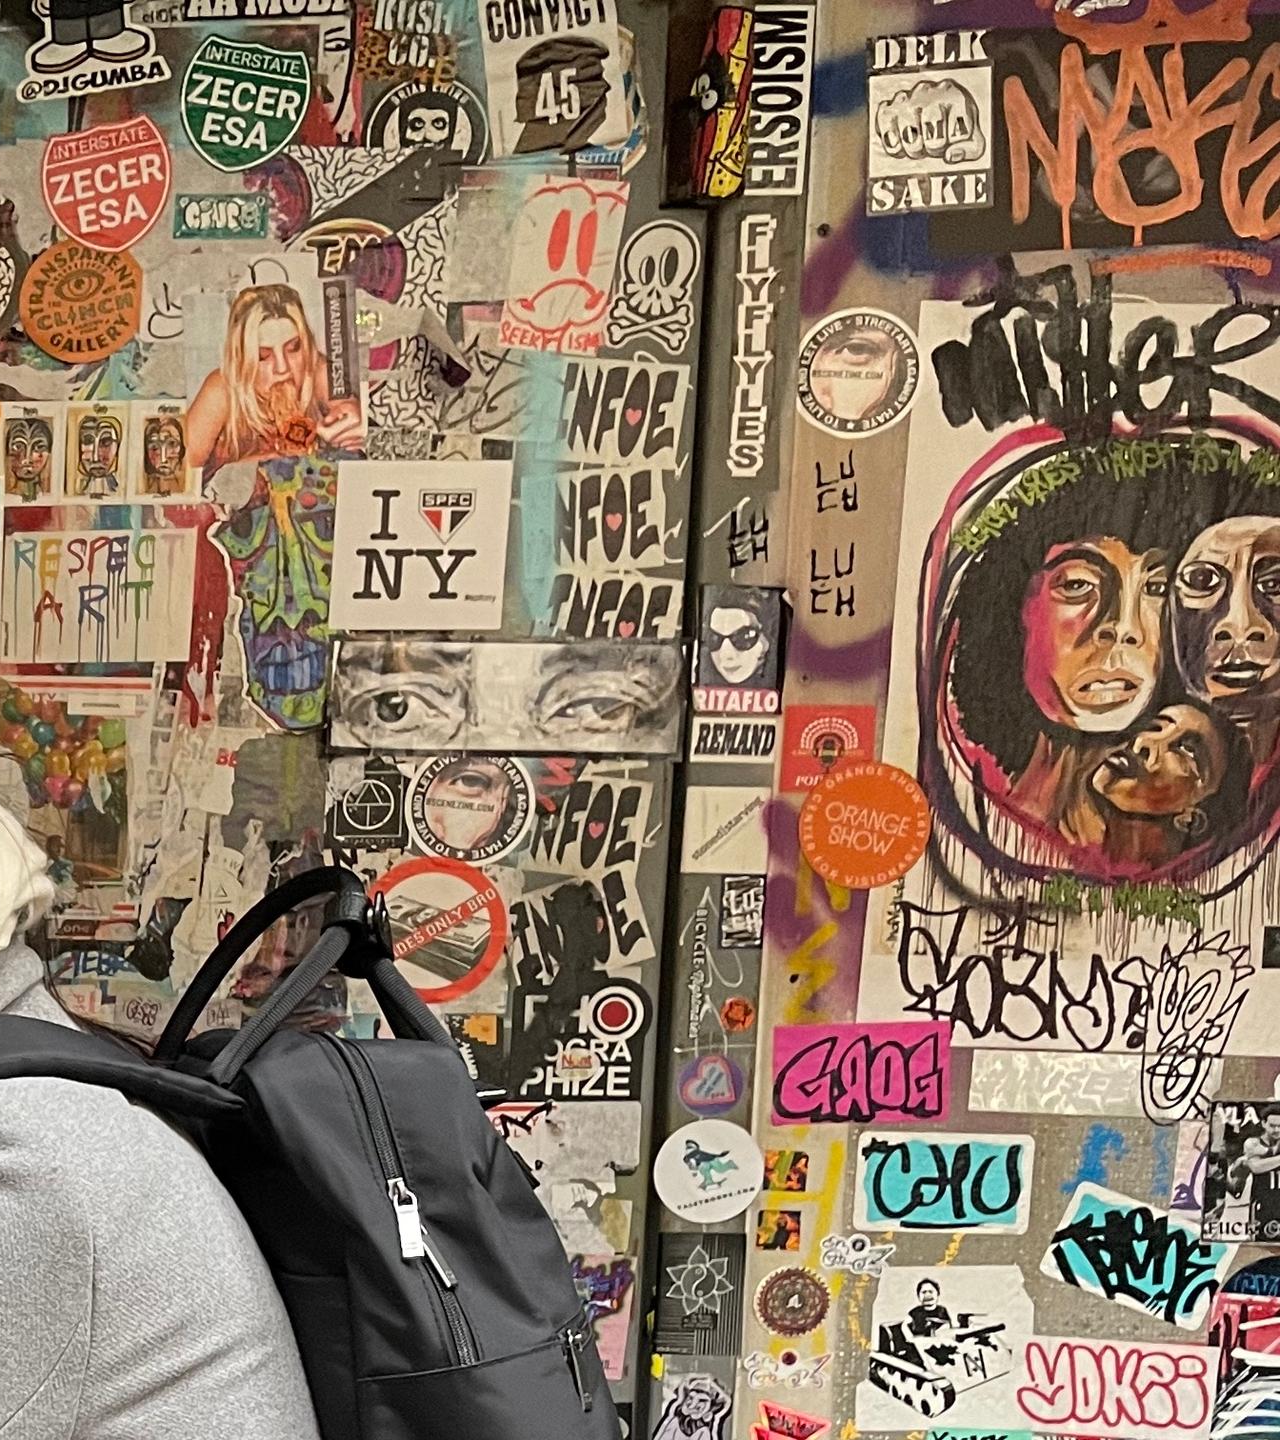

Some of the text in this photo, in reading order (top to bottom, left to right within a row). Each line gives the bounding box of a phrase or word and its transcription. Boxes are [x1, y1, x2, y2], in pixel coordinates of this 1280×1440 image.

[204, 45, 301, 76] INTERSTATE
[871, 31, 989, 69] DELK
[187, 72, 303, 121] ZECER
[537, 75, 581, 125] 45
[52, 125, 149, 160] INTERSTATE
[201, 117, 267, 151] ESA
[883, 102, 967, 157] COMA
[51, 155, 164, 204] ZECER
[871, 173, 987, 213] SAKE
[78, 200, 147, 233] ESA
[50, 319, 132, 354] GALLERY
[371, 490, 401, 541] I
[422, 493, 471, 507] SPFC
[353, 549, 476, 600] NY
[693, 688, 778, 713] RITAFLO
[694, 724, 775, 755] REMAND
[824, 802, 911, 838] ORANGE
[828, 828, 893, 857] SHOW
[467, 887, 496, 917] BRO
